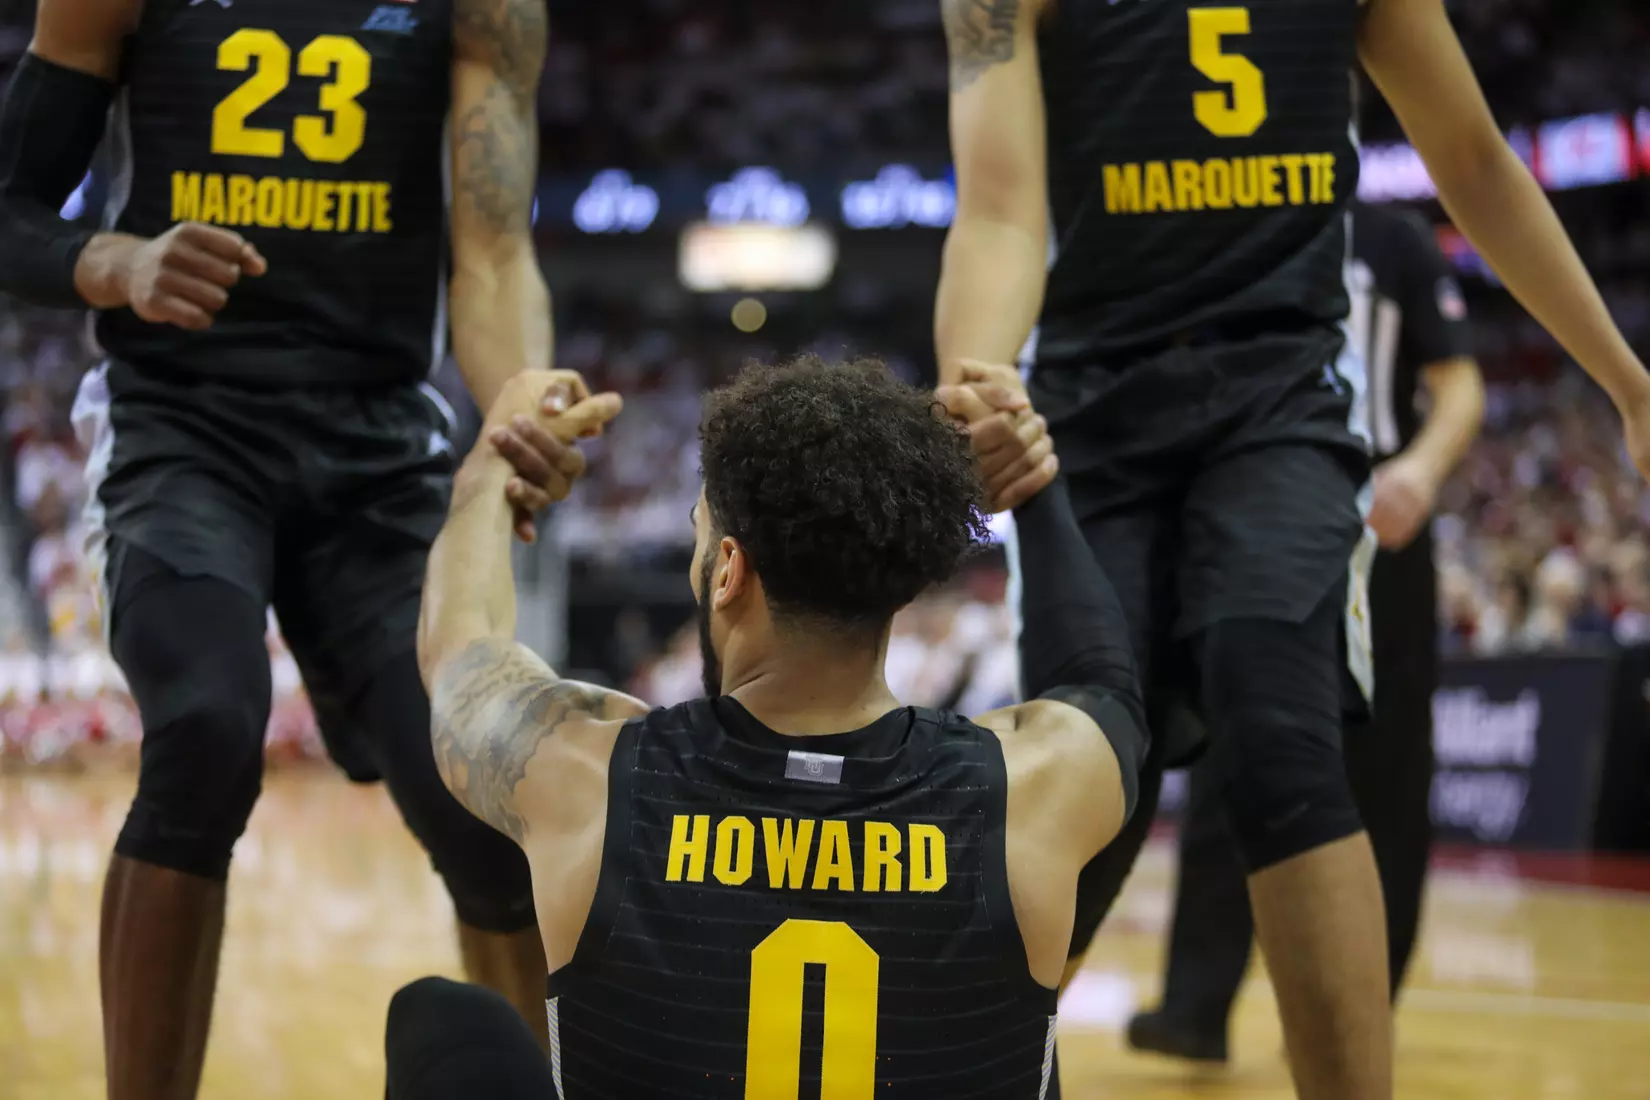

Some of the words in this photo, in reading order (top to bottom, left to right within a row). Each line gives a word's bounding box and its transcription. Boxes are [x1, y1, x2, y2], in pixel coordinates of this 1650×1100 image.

[211, 28, 371, 162] 23
[1188, 7, 1268, 137] 5
[171, 171, 392, 233] MARQUETTE
[1102, 152, 1335, 214] MARQUETTE
[666, 815, 948, 892] HOWARD
[744, 918, 880, 1100] 0
